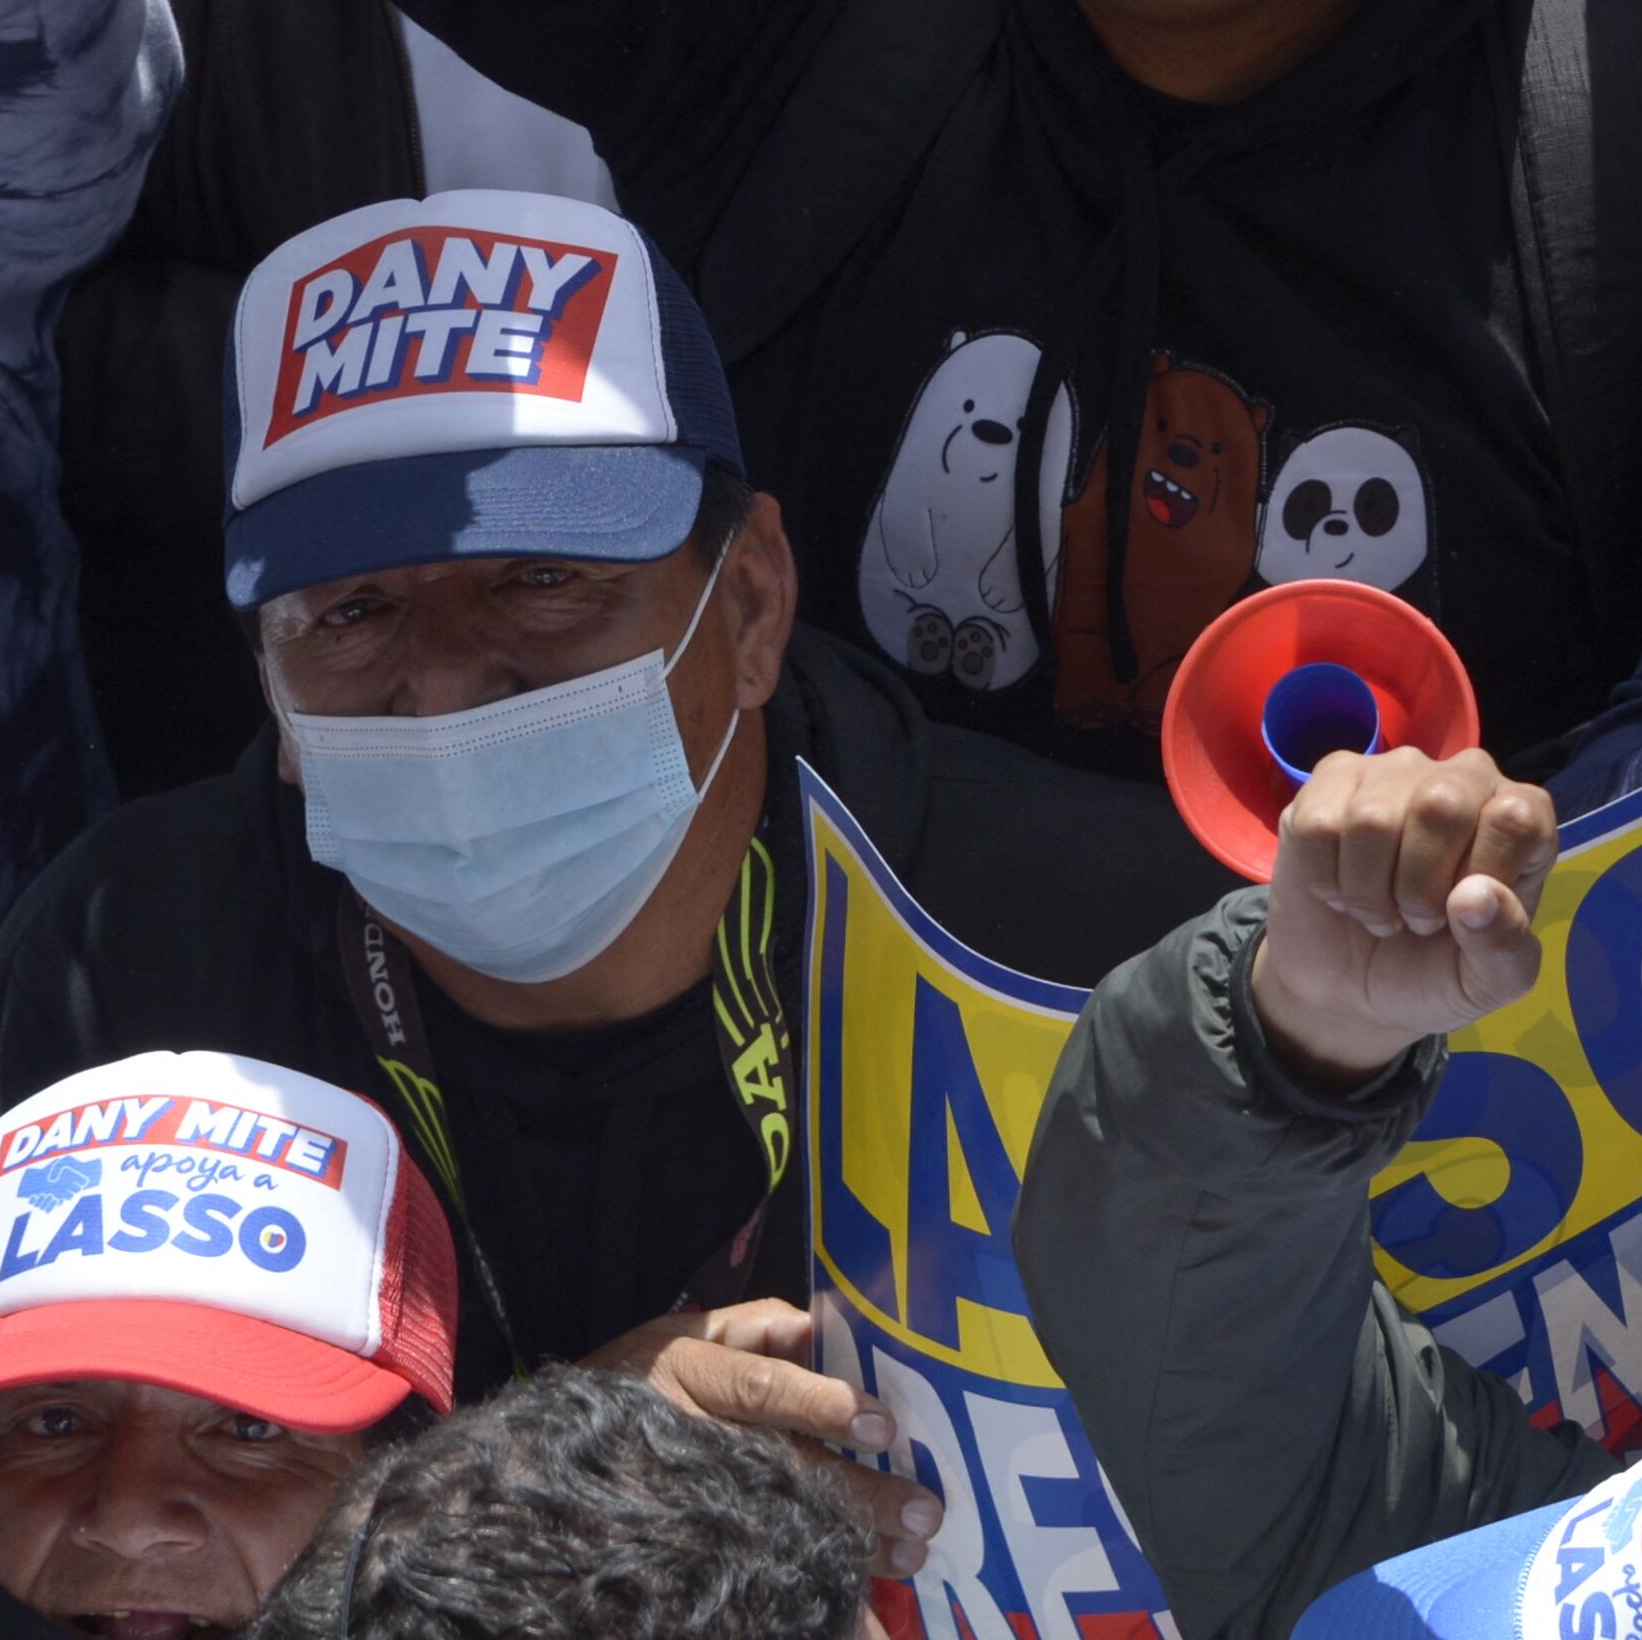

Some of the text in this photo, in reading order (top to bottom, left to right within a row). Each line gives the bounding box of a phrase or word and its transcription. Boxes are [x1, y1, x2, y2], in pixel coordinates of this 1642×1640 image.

[293, 236, 603, 353] DANY
[292, 308, 555, 418] MITE
[364, 904, 406, 1047] HOND
[2, 1096, 339, 1180] DANY MITE
[120, 1151, 279, 1192] apoya a
